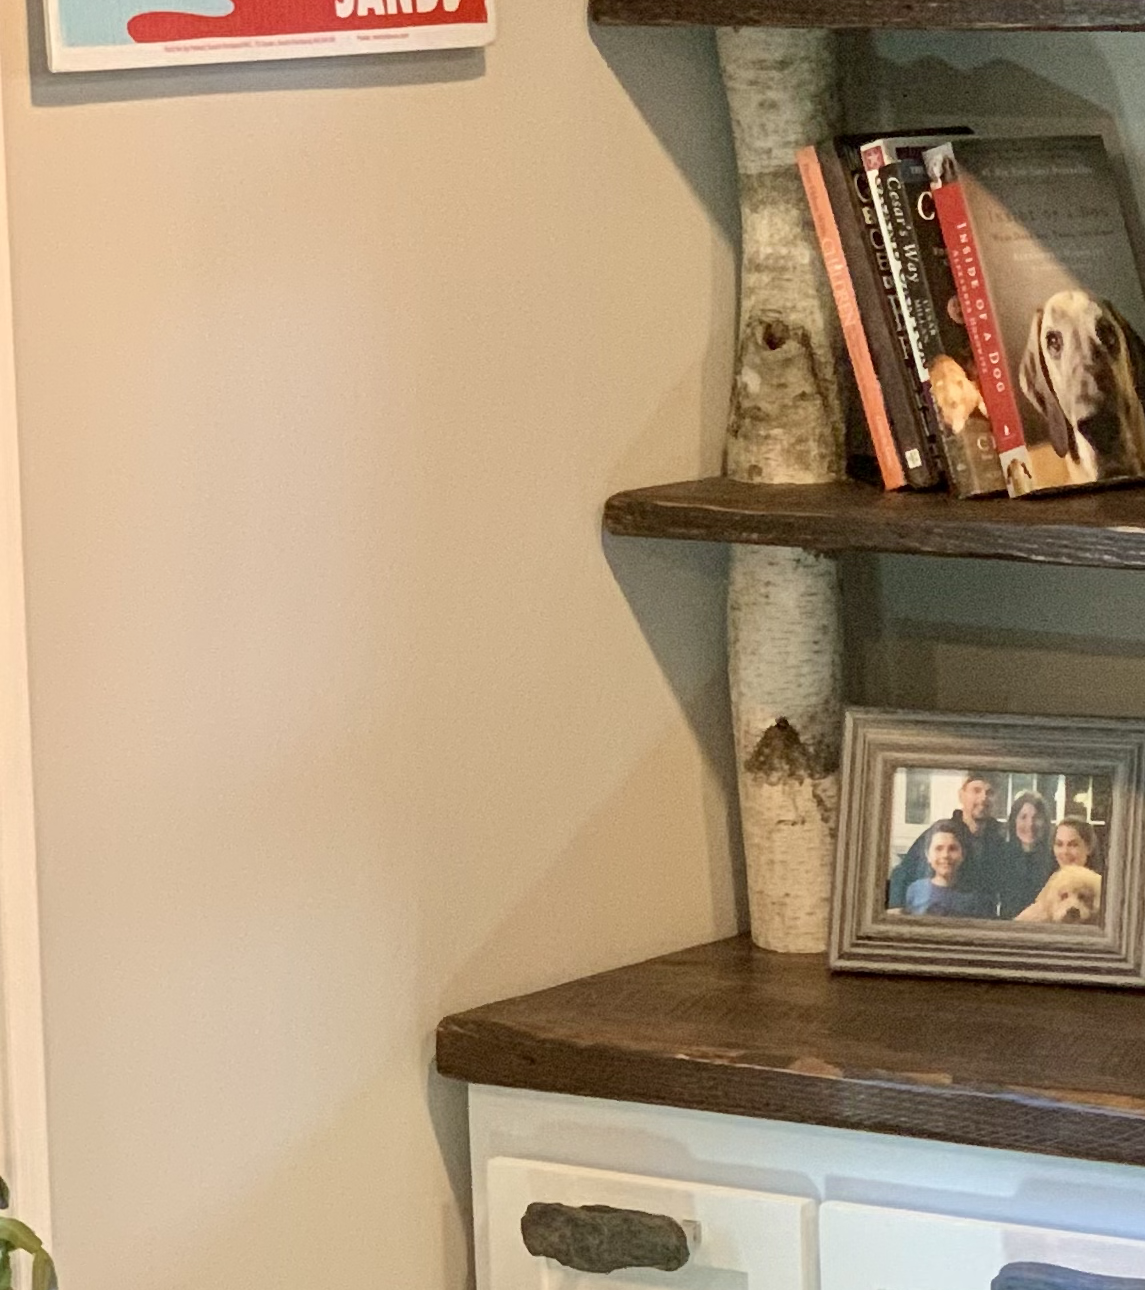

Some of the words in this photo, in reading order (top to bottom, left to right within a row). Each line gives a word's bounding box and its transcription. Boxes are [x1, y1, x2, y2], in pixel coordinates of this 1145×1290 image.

[886, 176, 912, 237] Cesar's
[903, 243, 919, 283] Way
[956, 222, 980, 289] INSIDE
[975, 299, 988, 321] OF
[983, 332, 992, 342] A
[988, 351, 1006, 393] DOG
